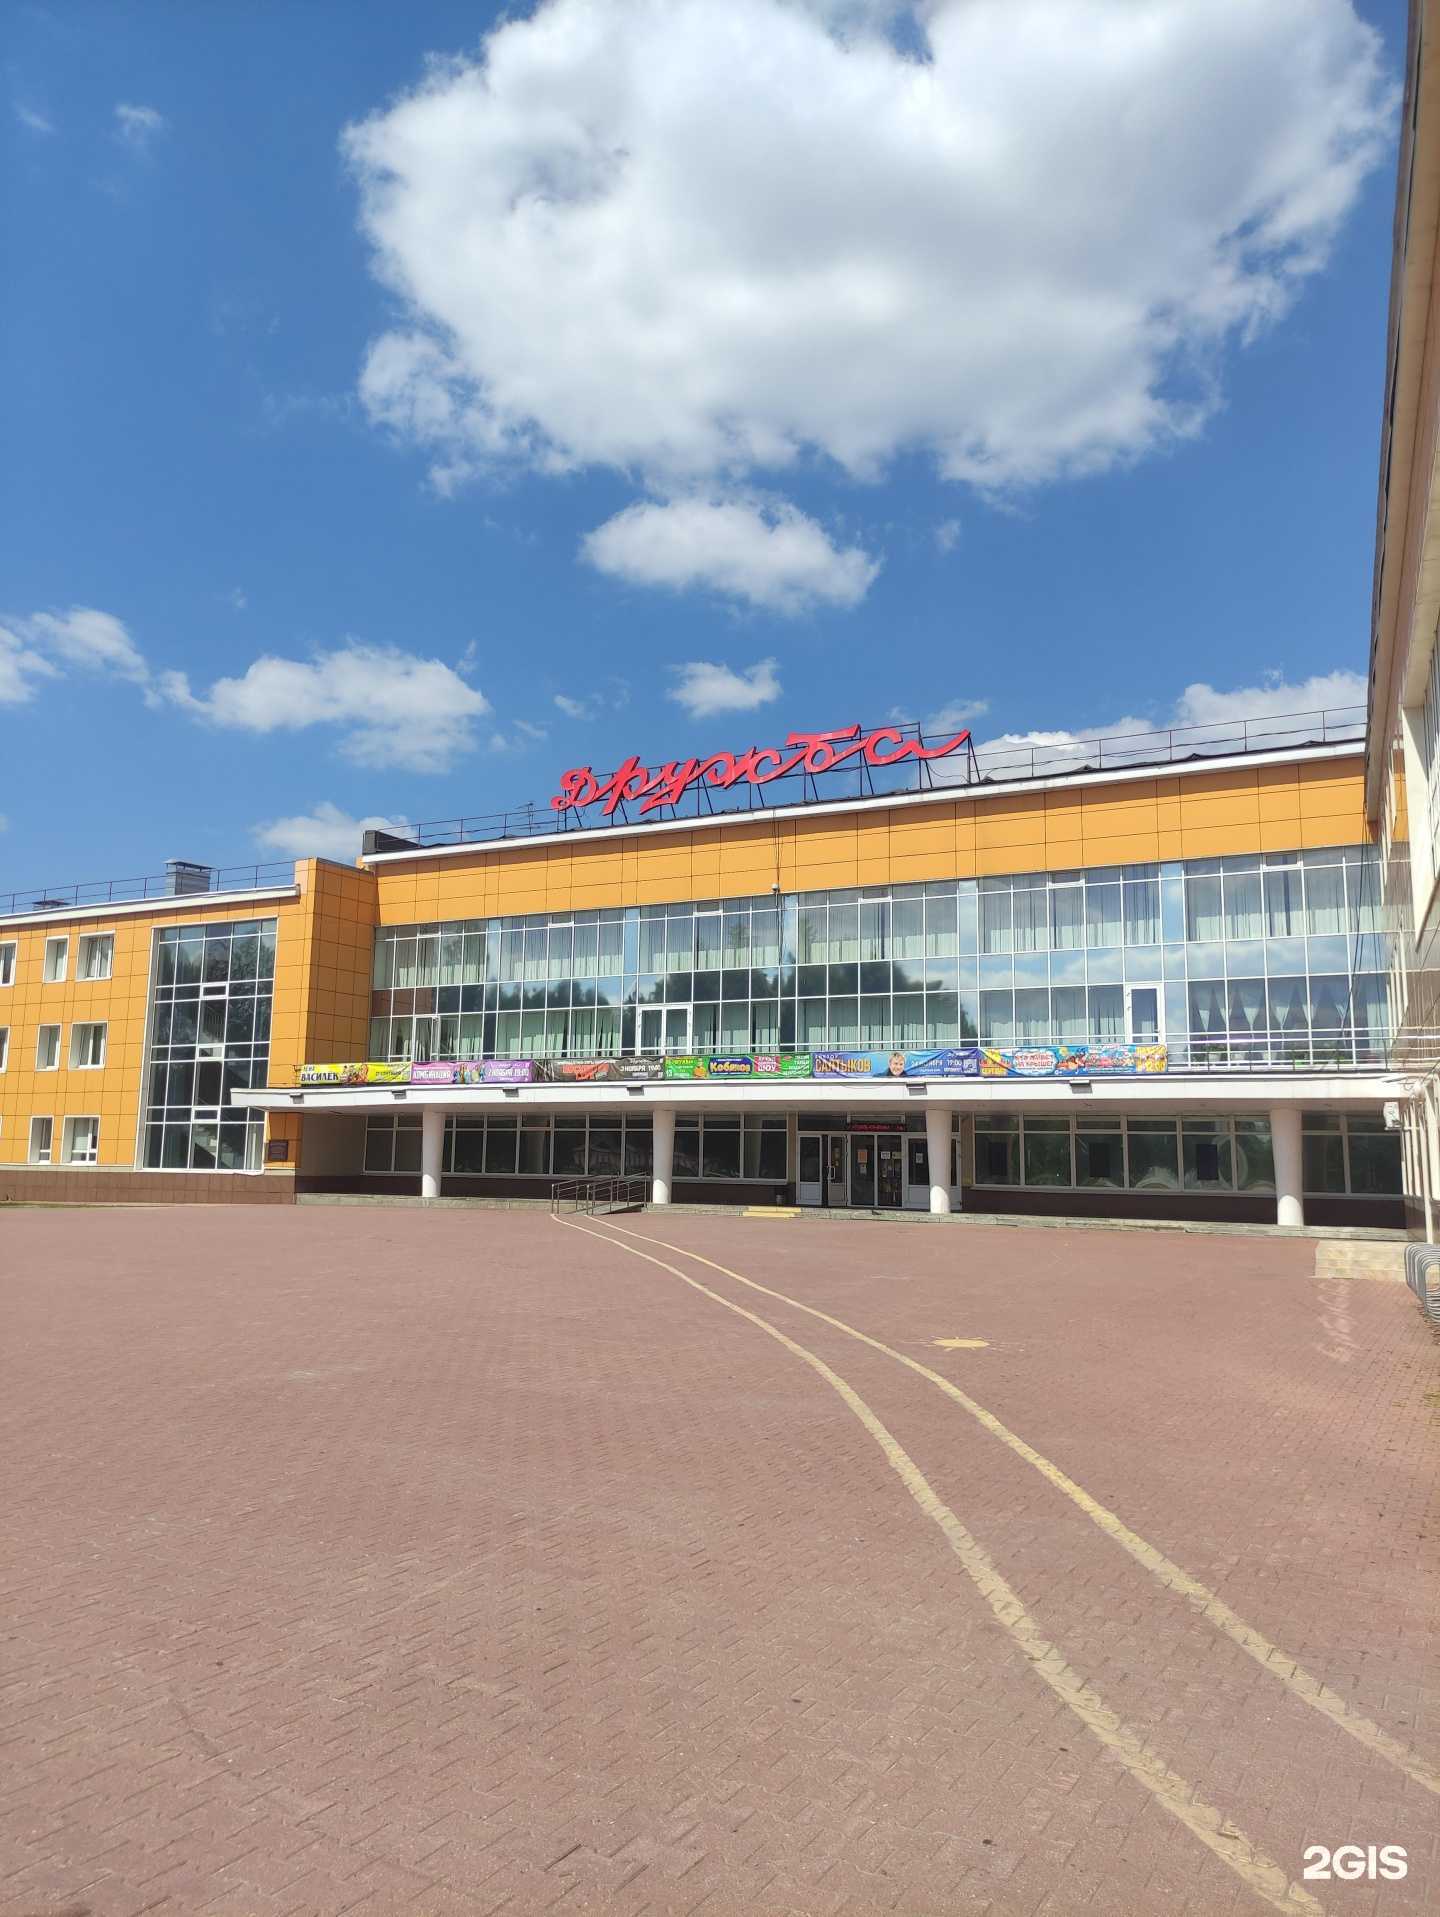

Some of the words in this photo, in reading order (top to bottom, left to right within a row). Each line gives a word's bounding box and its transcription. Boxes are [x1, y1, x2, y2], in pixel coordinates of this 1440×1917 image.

[550, 723, 971, 815] Дружба
[758, 1064, 776, 1072] ШОУ
[815, 1058, 872, 1072] САЛТЫКОВ
